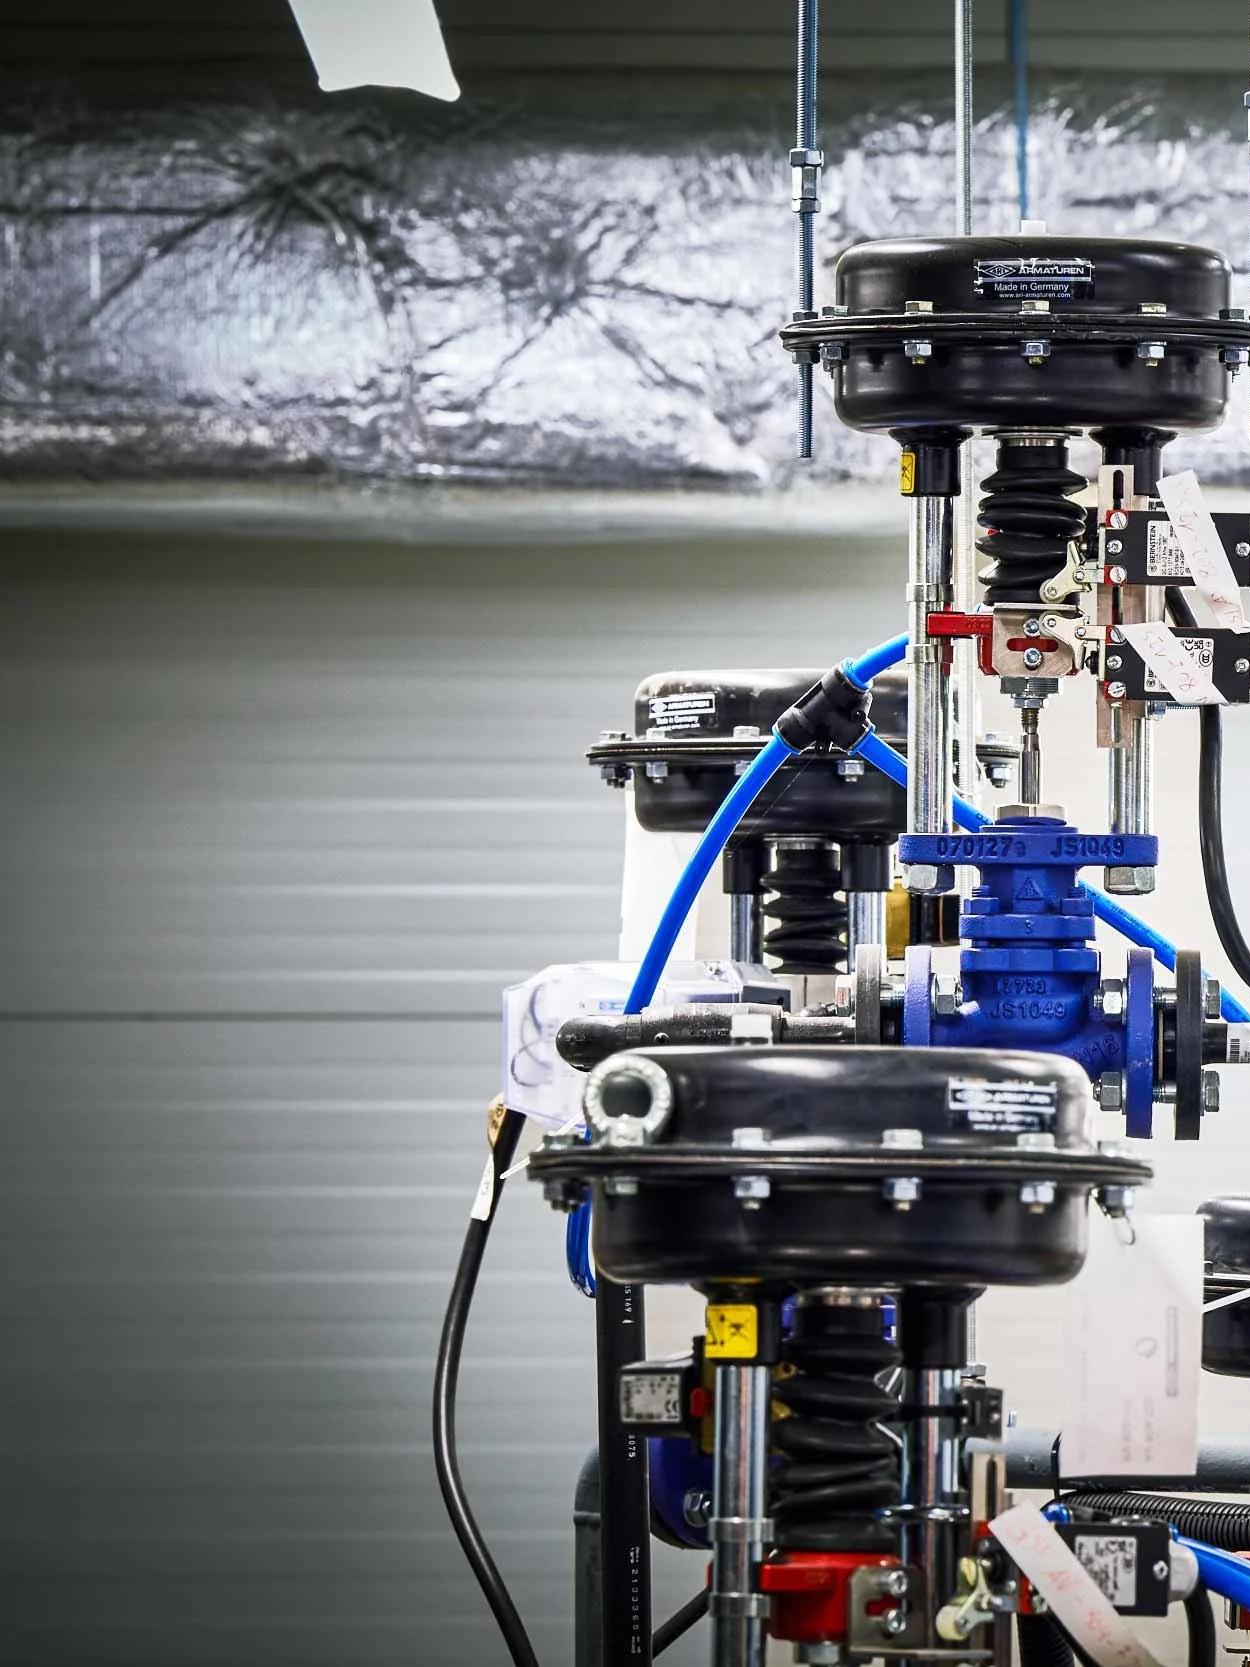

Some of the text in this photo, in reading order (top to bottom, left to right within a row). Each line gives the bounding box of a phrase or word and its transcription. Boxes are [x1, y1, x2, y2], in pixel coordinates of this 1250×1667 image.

[1019, 266, 1085, 276] ARMATUREN
[994, 283, 1069, 293] Made in Germany
[1050, 836, 1126, 858] JS1049
[990, 1000, 1067, 1019] JS1049
[1072, 1033, 1120, 1065] N16
